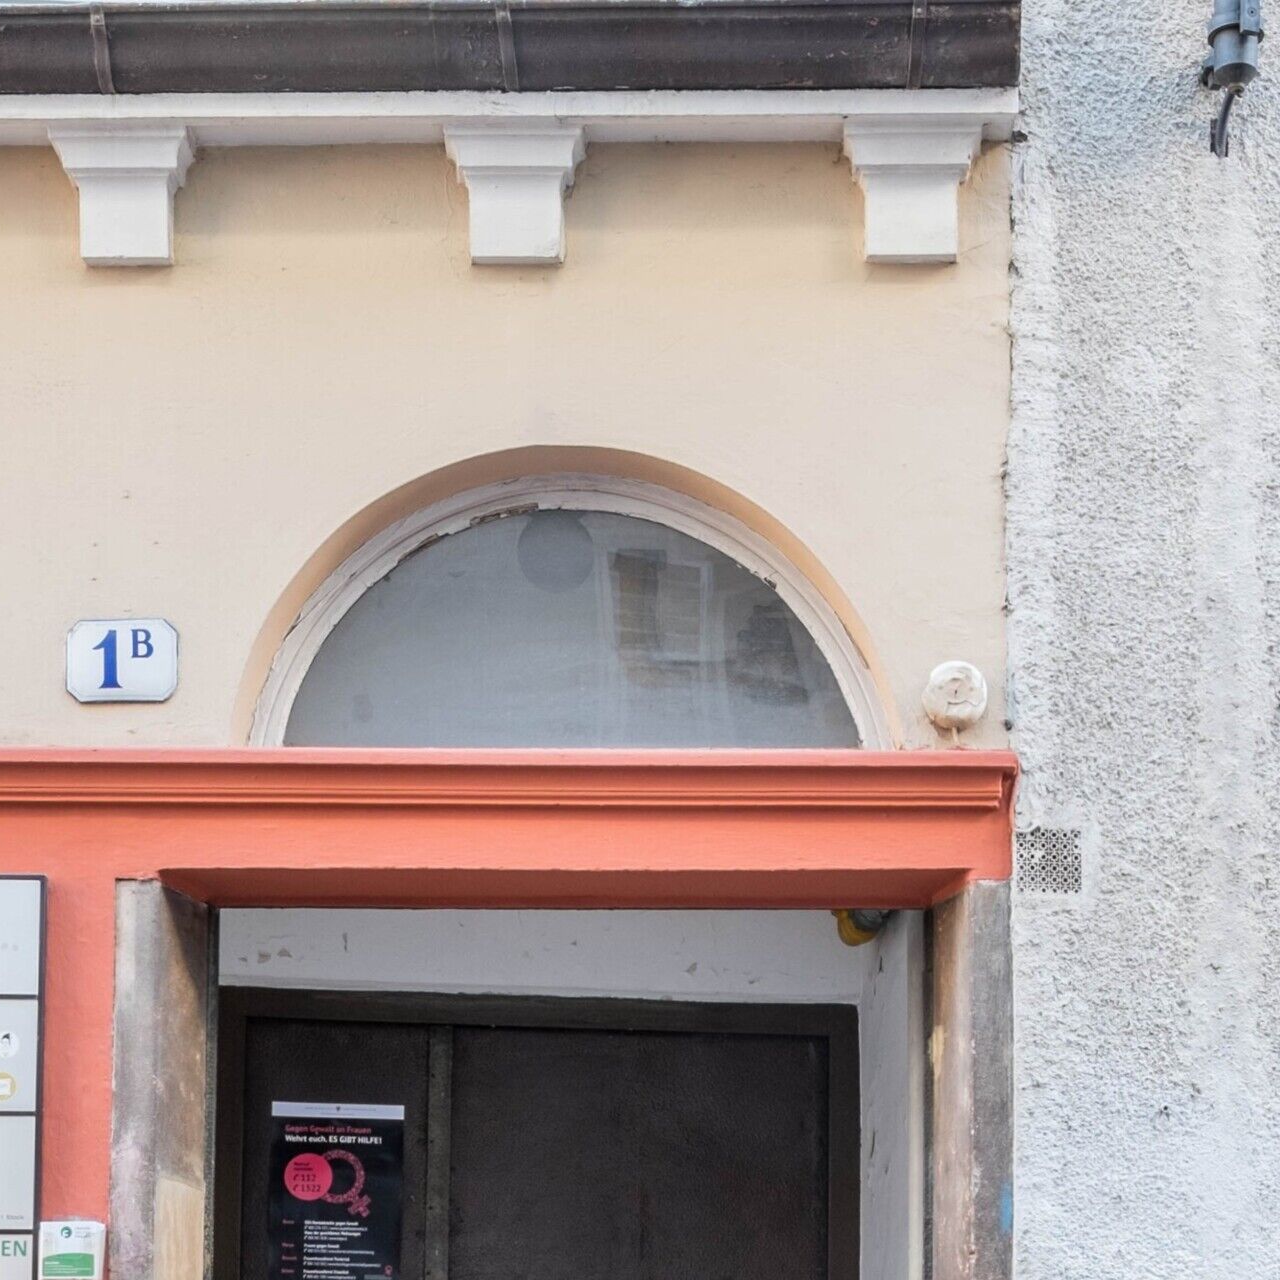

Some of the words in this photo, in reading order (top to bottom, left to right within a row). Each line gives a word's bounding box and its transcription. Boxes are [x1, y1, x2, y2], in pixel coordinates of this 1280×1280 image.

[285, 1125, 308, 1133] Gegen
[309, 1125, 334, 1133] Gewalt
[346, 1126, 372, 1134] Frauen
[328, 1135, 338, 1143] ES
[339, 1135, 357, 1144] GIBT
[357, 1136, 382, 1144] HILFE!
[301, 1174, 316, 1182] 112
[301, 1184, 321, 1192] 1522
